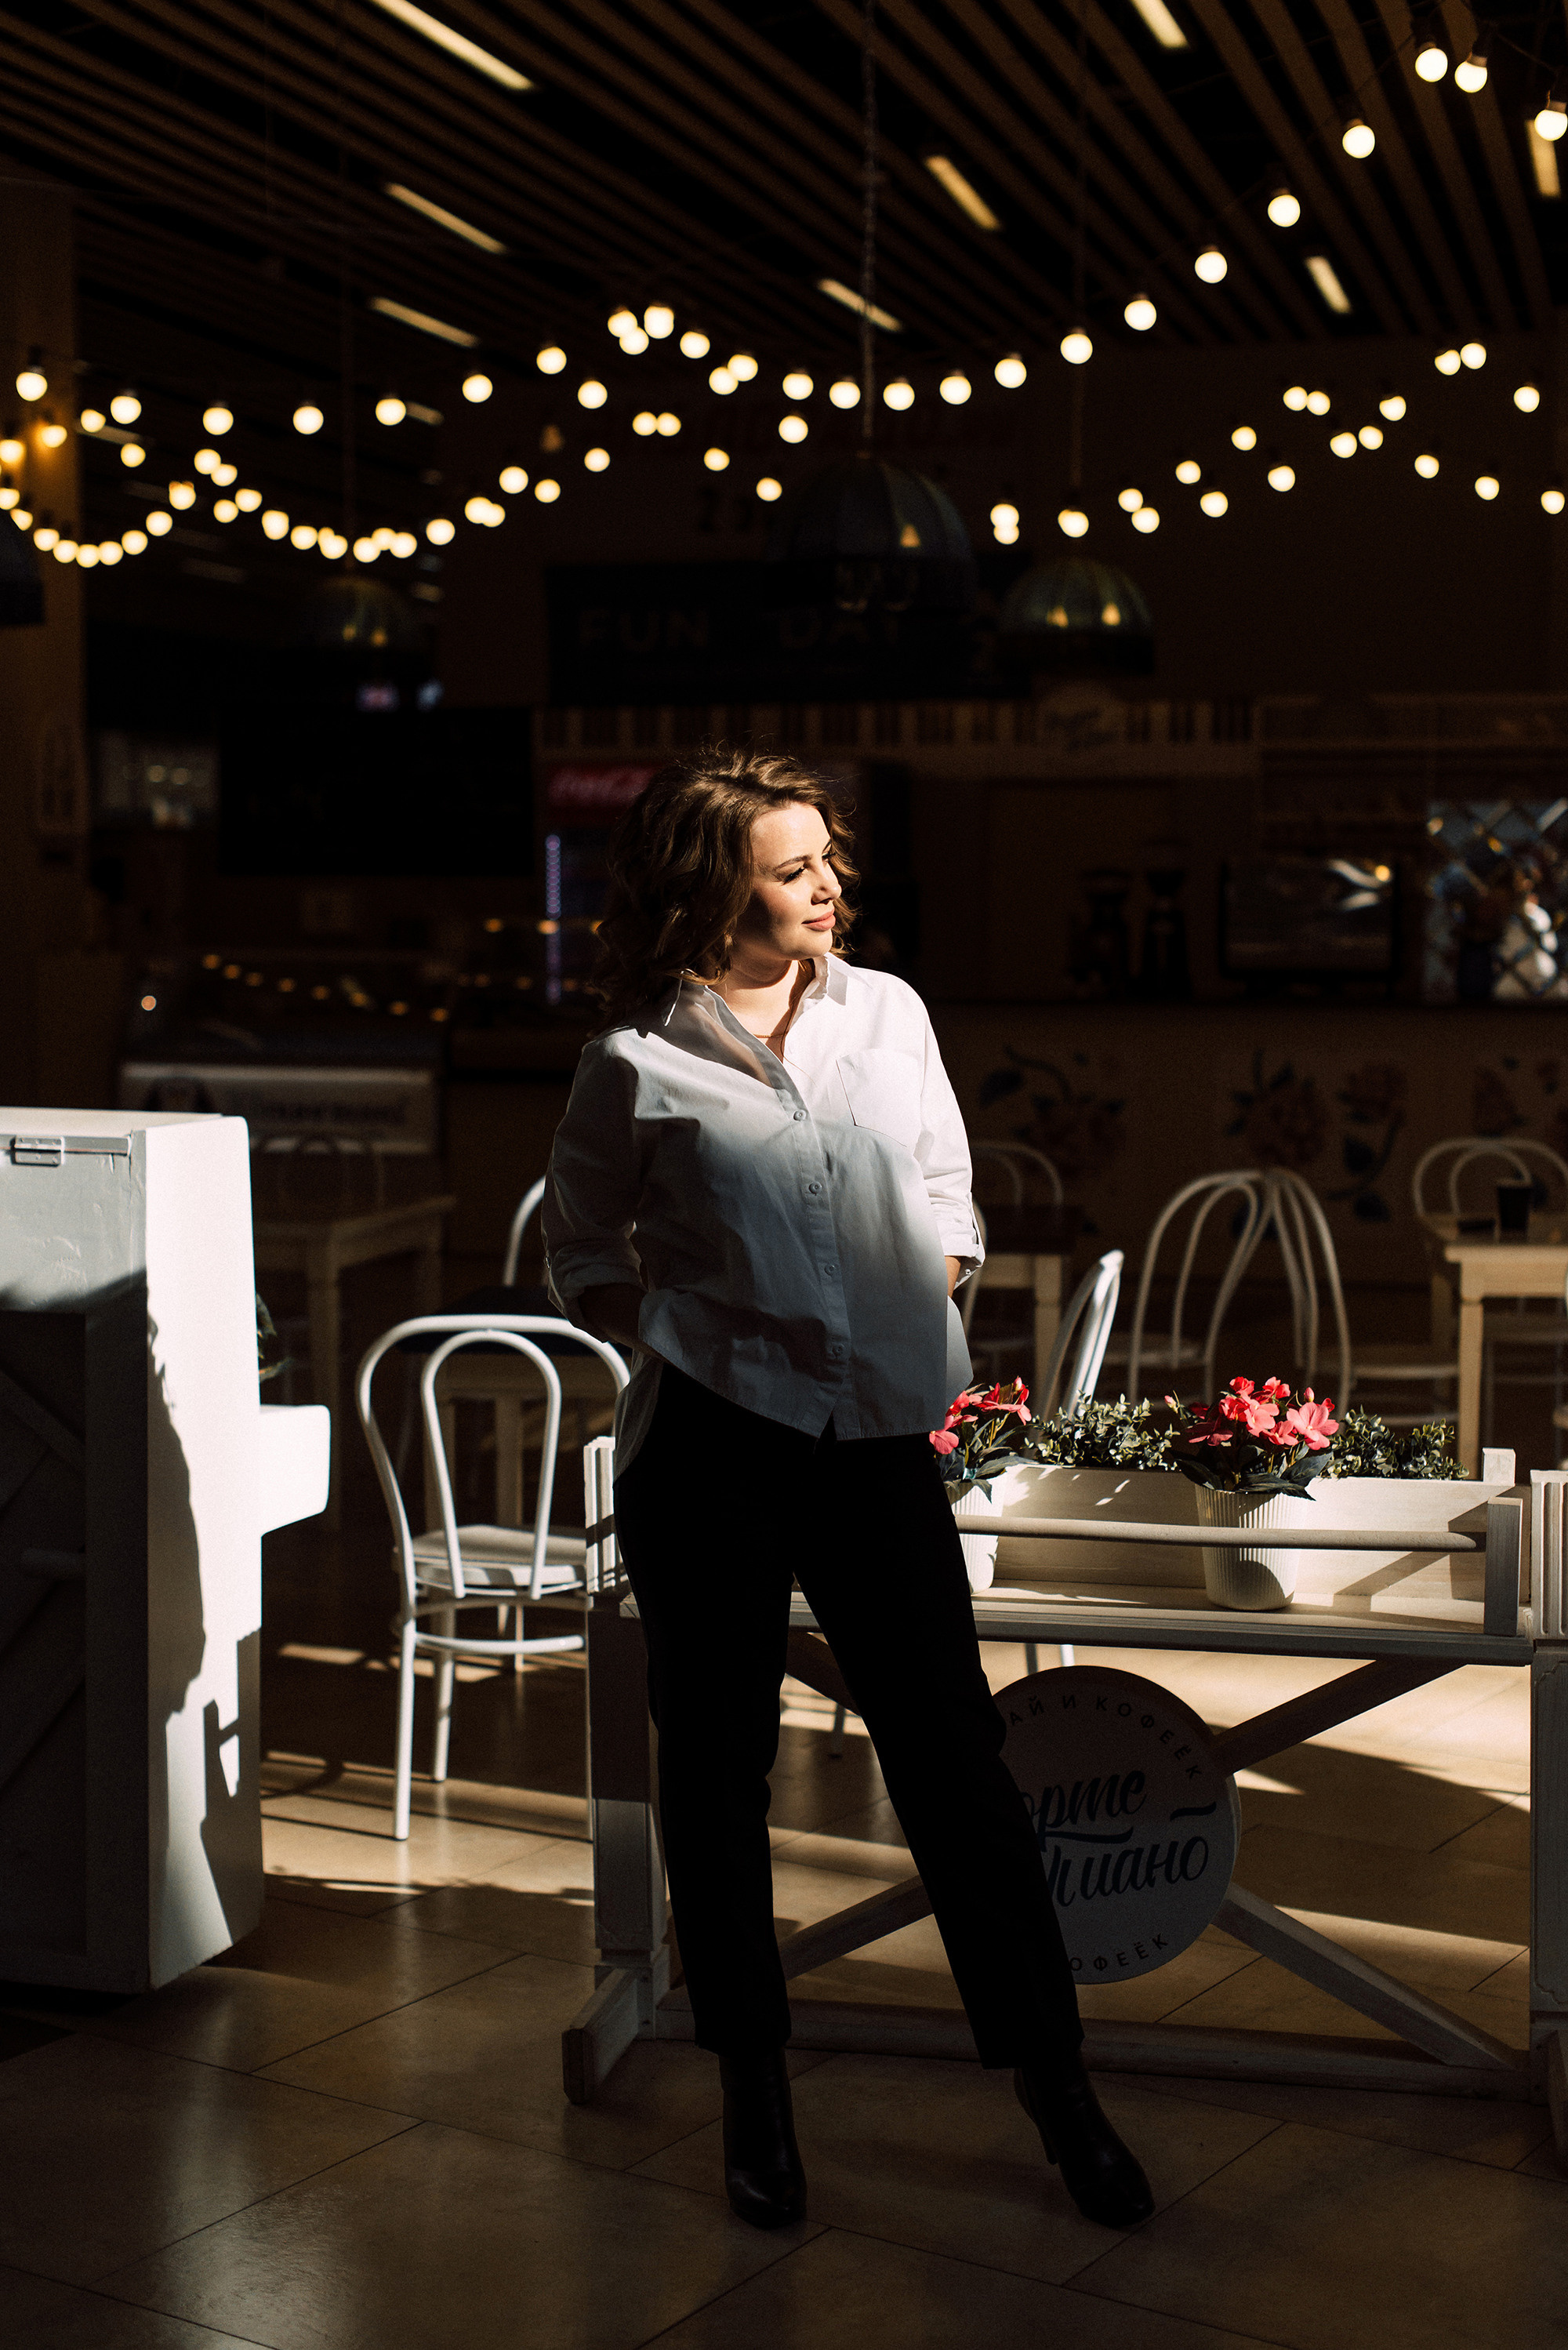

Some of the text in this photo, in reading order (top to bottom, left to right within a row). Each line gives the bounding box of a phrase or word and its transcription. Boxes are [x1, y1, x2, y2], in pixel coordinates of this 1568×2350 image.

[578, 607, 711, 652] FUN
[1009, 1695, 1044, 1727] АЙ
[1021, 1770, 1148, 1853] орте
[1070, 1933, 1168, 1973] ОФЕЁК
